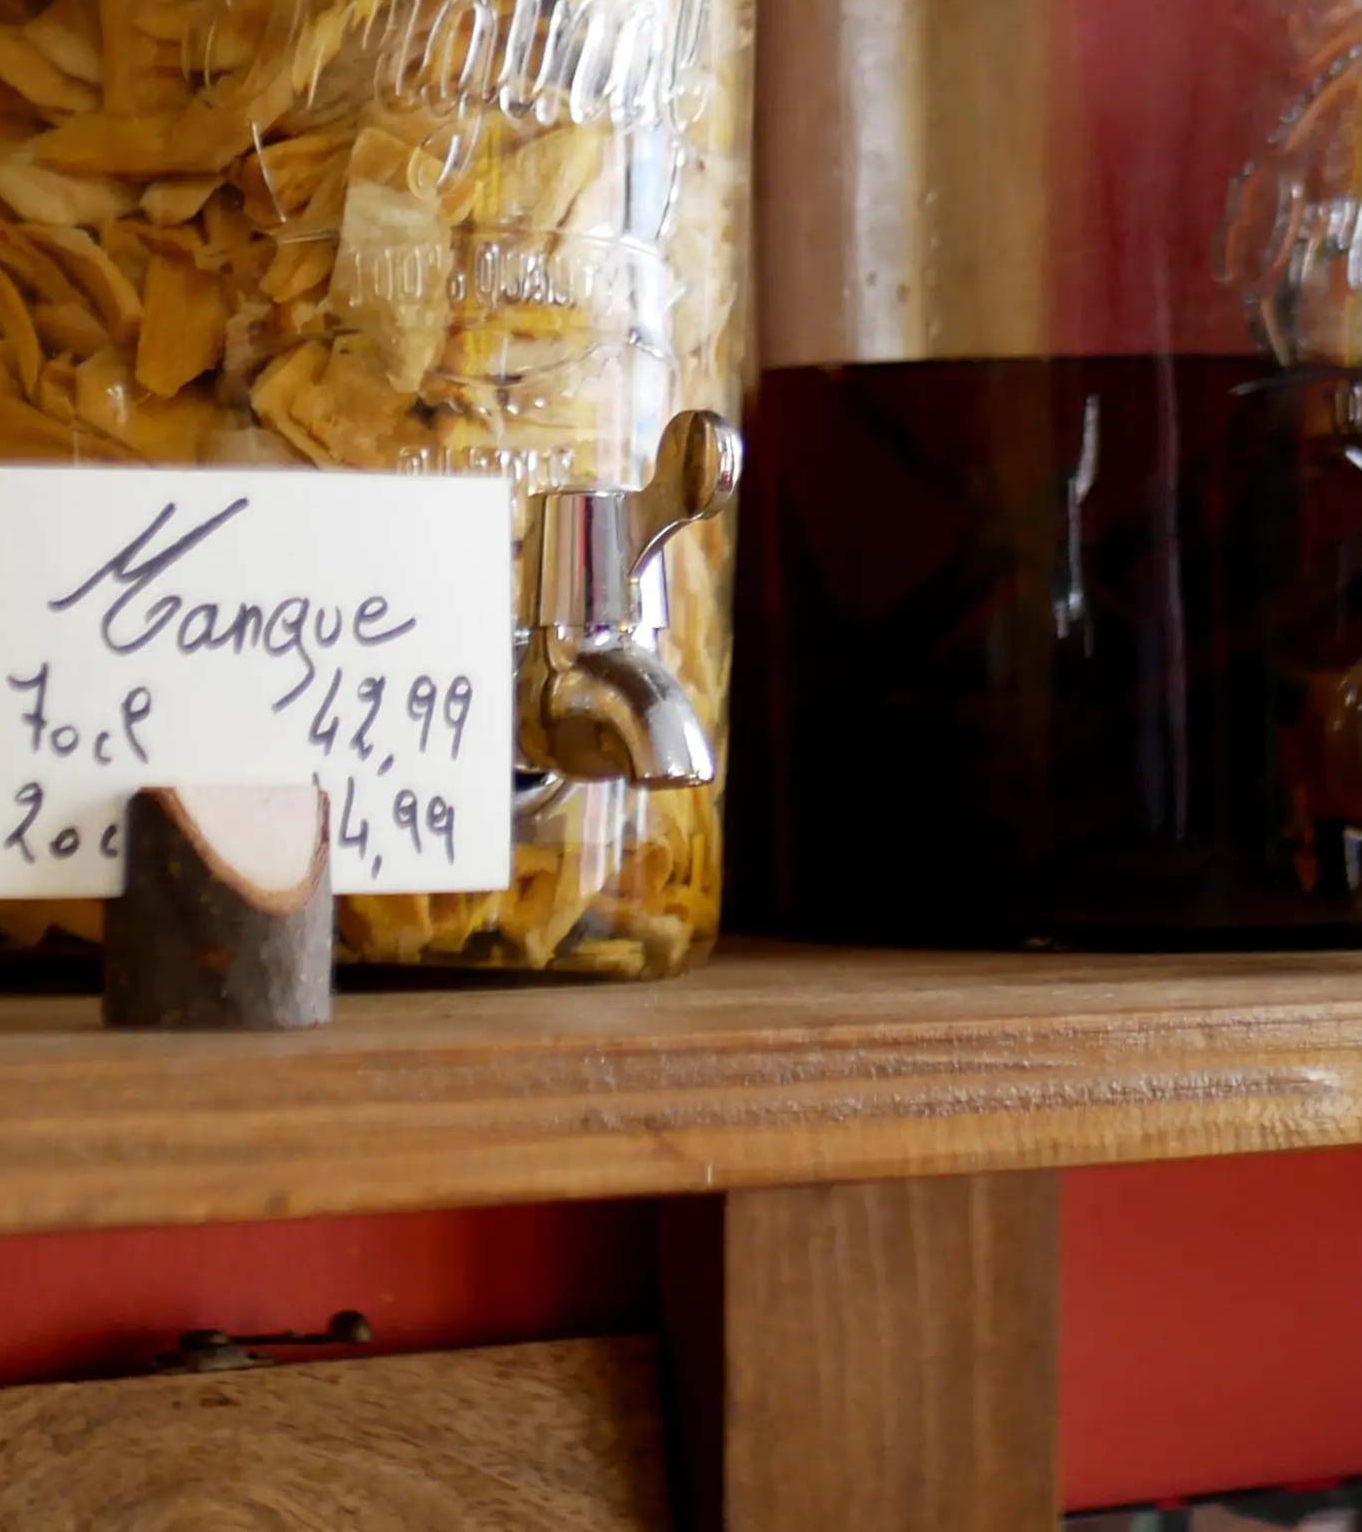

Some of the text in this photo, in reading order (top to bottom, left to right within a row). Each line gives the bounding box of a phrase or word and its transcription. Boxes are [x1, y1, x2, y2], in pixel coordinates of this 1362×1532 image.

[46, 497, 417, 714] Mangue
[2, 770, 457, 881] 20c 4,99
